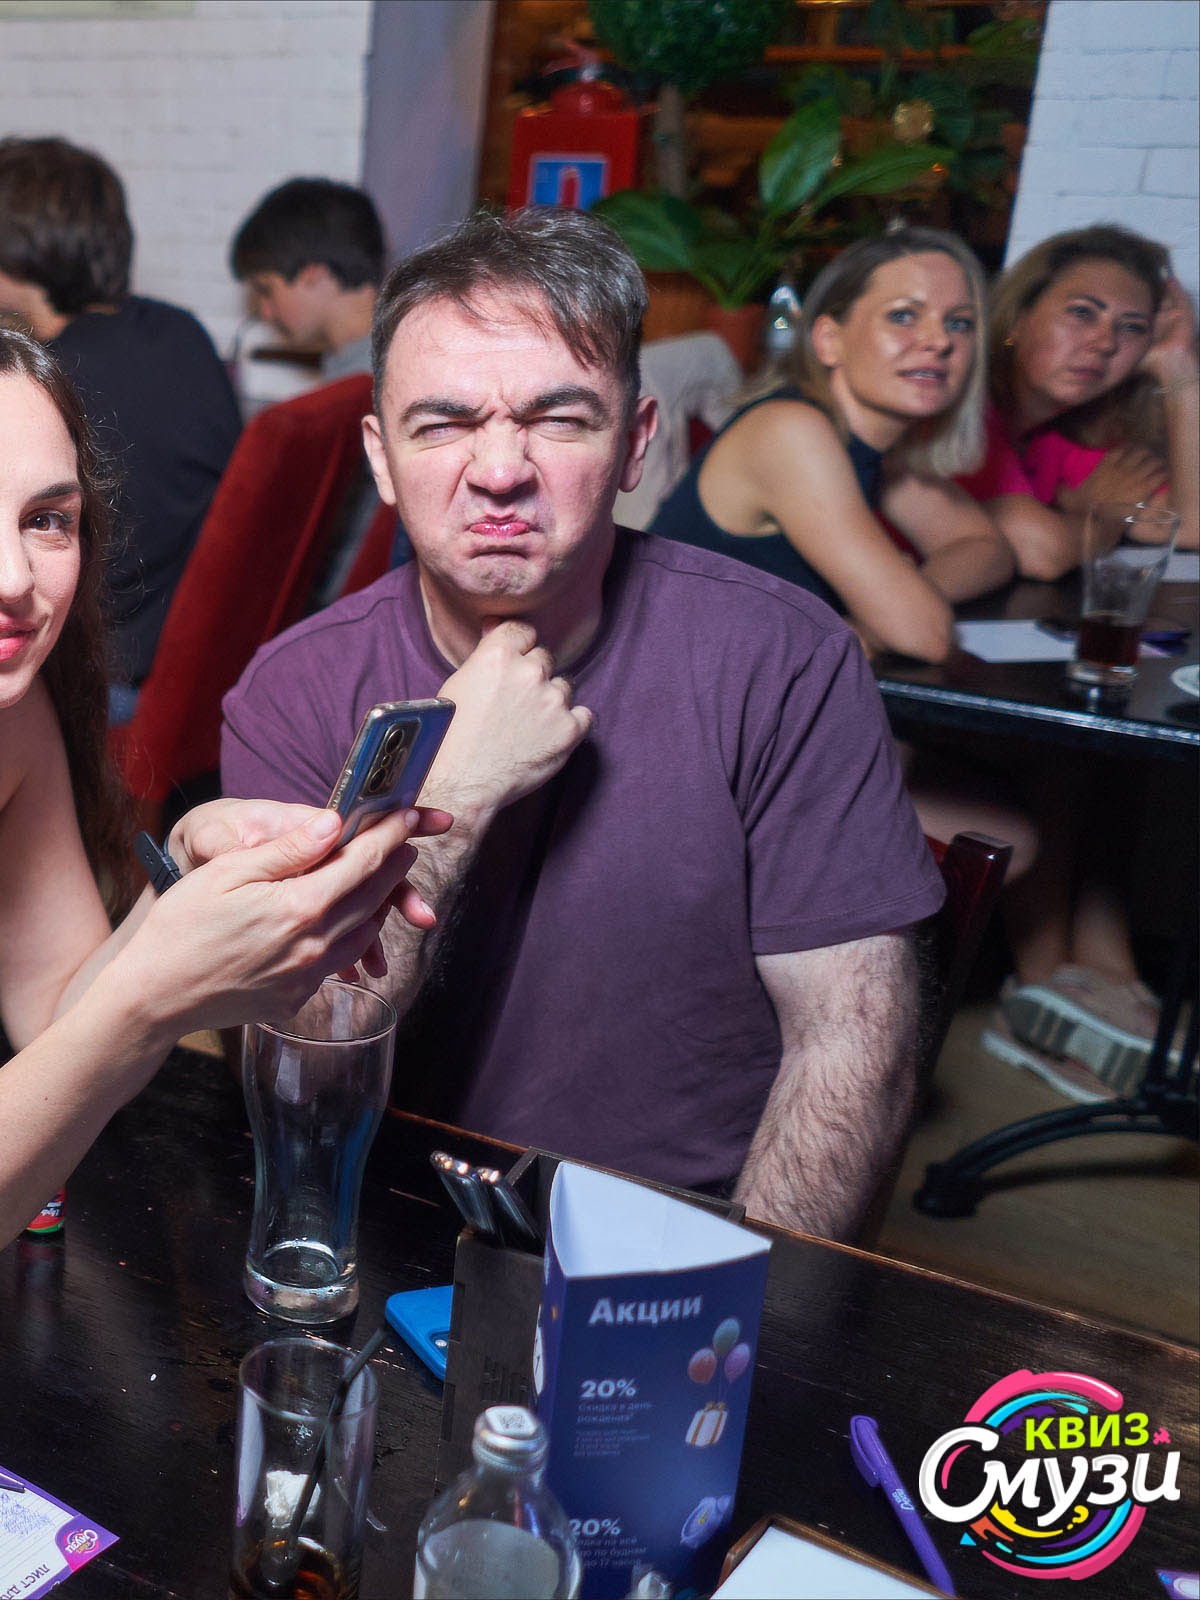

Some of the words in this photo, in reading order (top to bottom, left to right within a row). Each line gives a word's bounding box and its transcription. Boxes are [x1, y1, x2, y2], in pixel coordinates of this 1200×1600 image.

[588, 1295, 703, 1325] Акции
[580, 1377, 637, 1399] 20%
[569, 1517, 622, 1536] 20%
[20, 1564, 51, 1588] ЛИСТ
